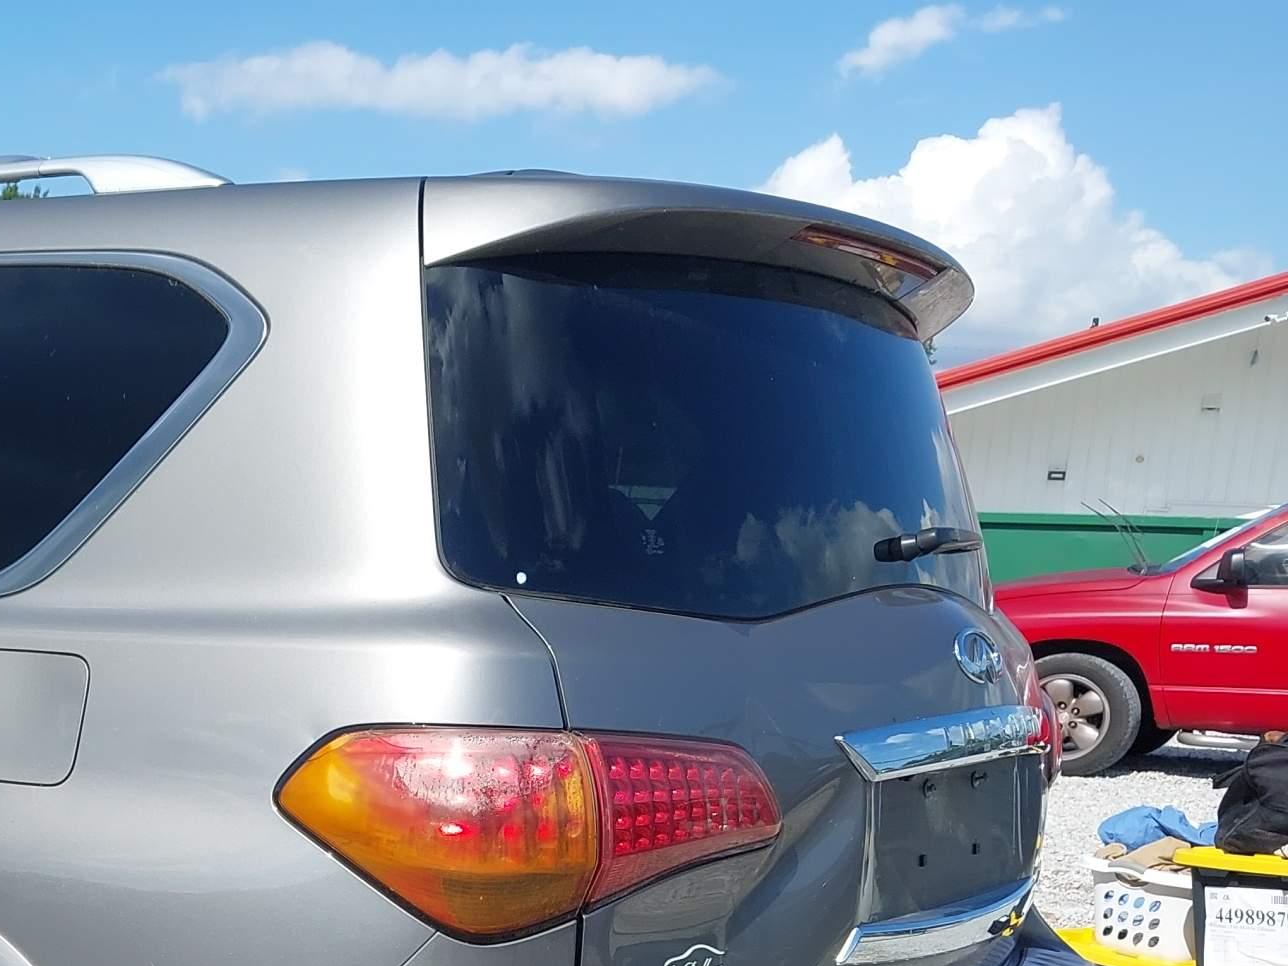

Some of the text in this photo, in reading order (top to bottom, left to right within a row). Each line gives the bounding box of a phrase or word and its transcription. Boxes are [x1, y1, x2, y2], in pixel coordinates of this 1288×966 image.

[1170, 643, 1257, 654] RAM 1500
[1215, 907, 1288, 927] 4498987
